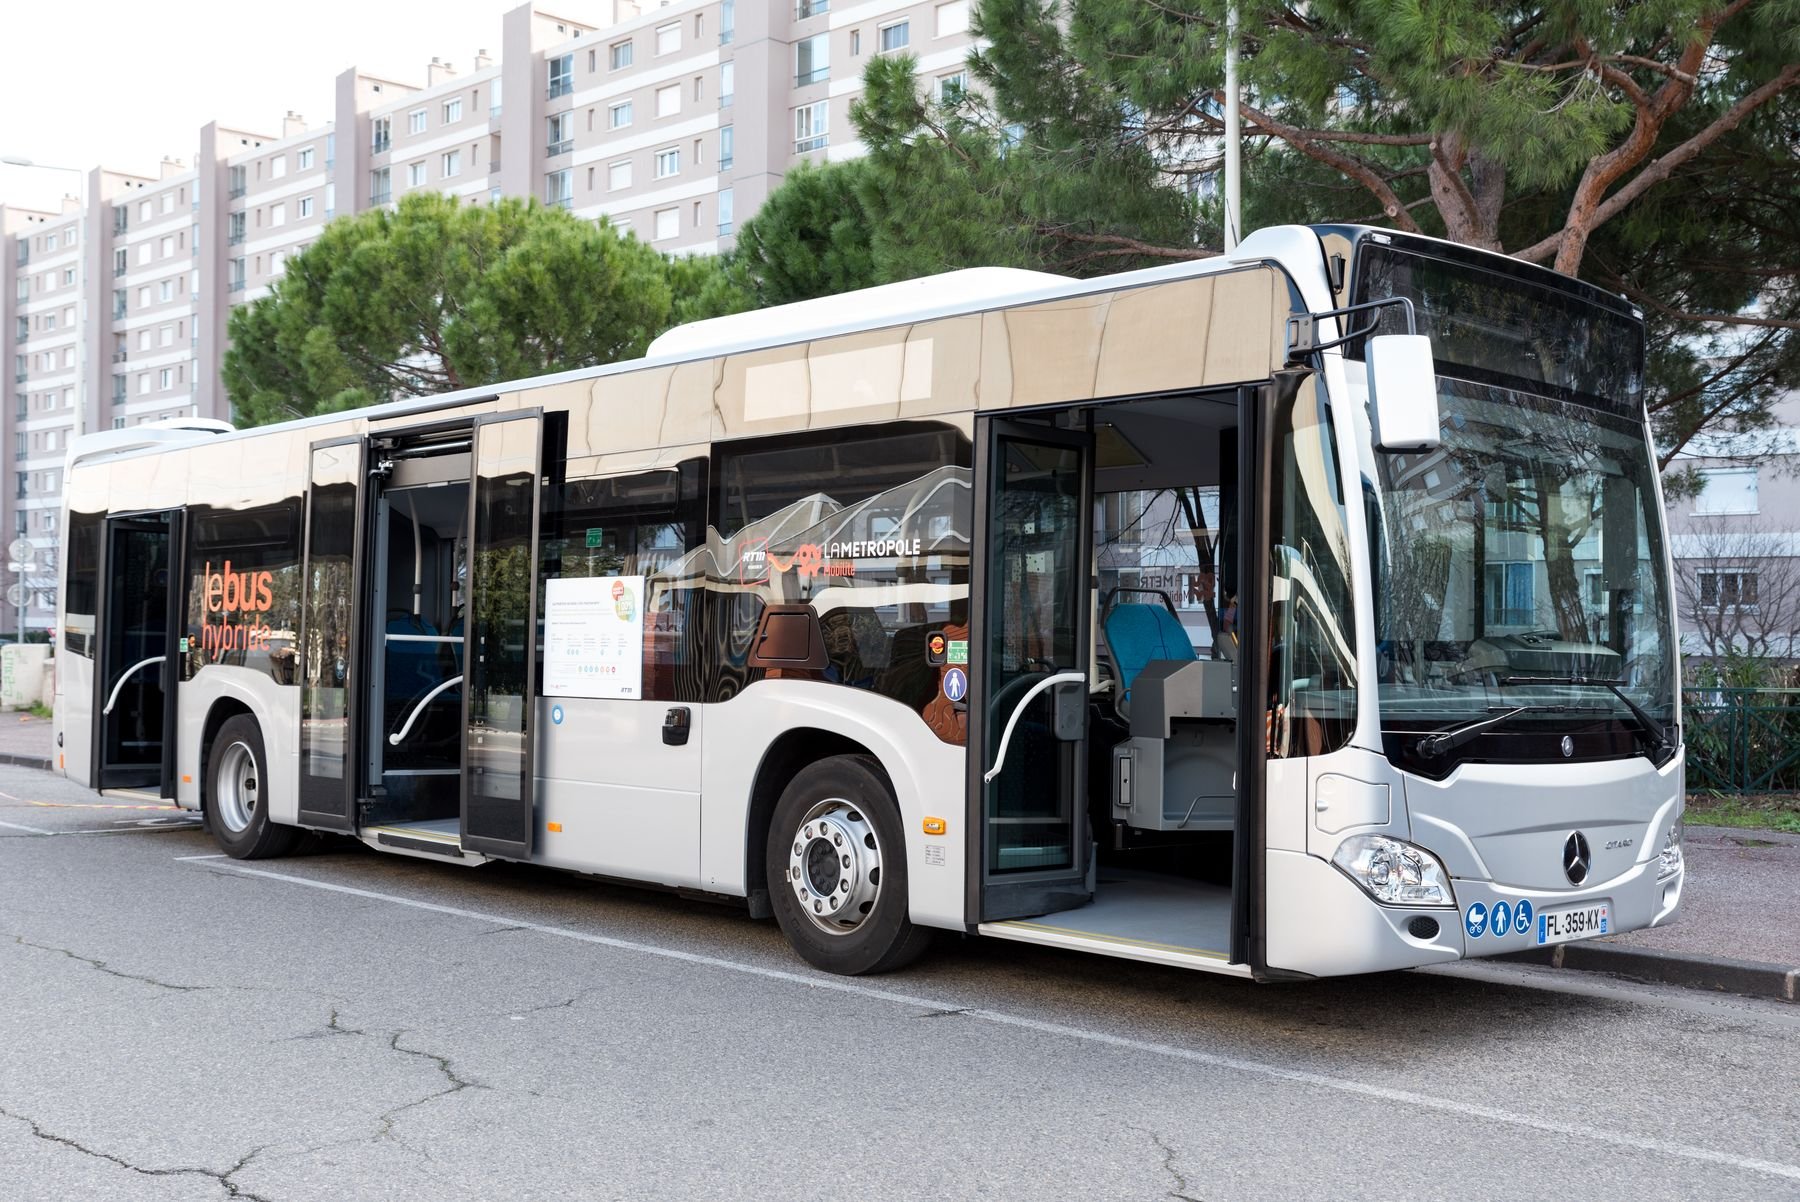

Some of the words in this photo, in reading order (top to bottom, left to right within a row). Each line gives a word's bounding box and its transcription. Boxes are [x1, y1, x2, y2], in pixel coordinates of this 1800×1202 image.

[742, 551, 766, 562] RTM
[823, 538, 921, 559] LAMETROPOLE
[203, 560, 273, 612] lebus
[201, 613, 272, 660] hybride
[1605, 839, 1633, 850] CITARO
[1547, 908, 1600, 937] FL-359-KX
